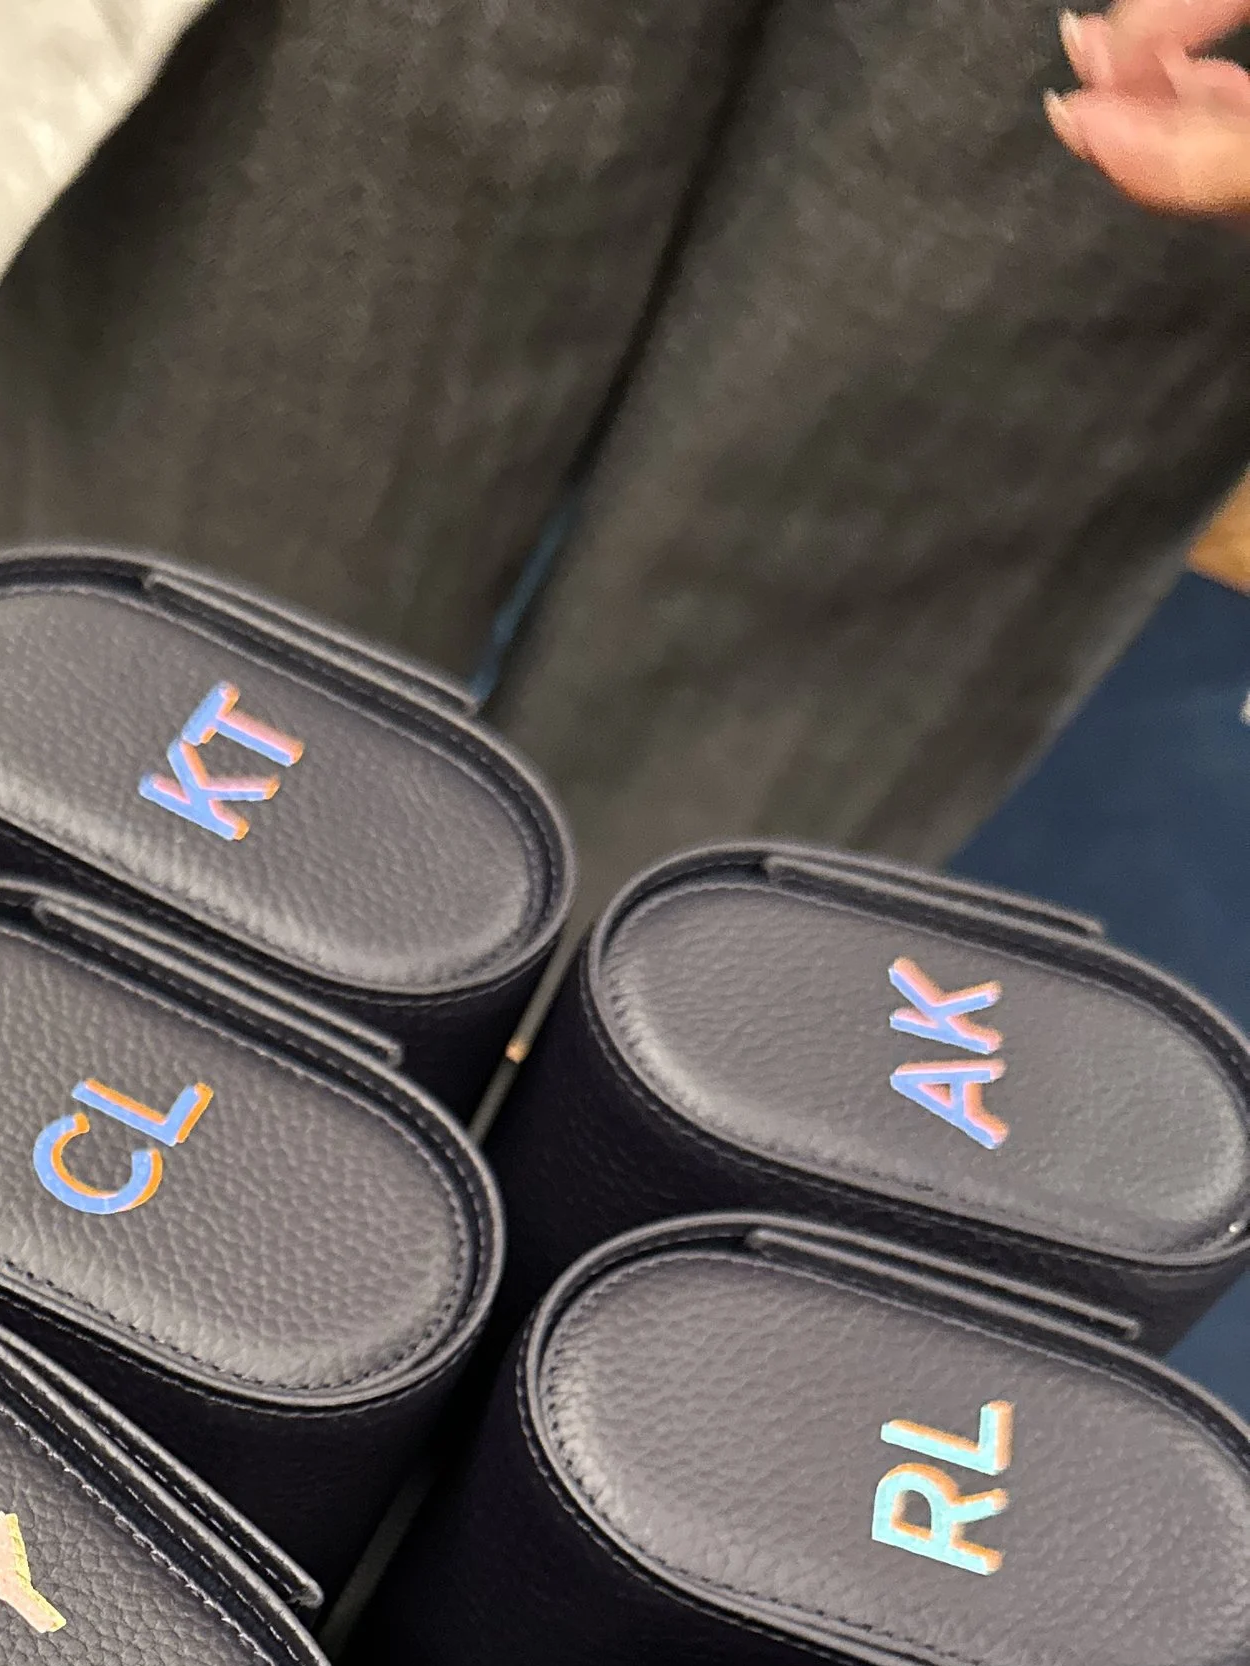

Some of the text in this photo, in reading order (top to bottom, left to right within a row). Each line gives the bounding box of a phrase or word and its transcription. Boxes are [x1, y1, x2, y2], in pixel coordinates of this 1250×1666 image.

[137, 680, 305, 840] KT
[887, 955, 1007, 1147] AK
[33, 1077, 217, 1213] CL
[869, 1398, 1014, 1577] RL
